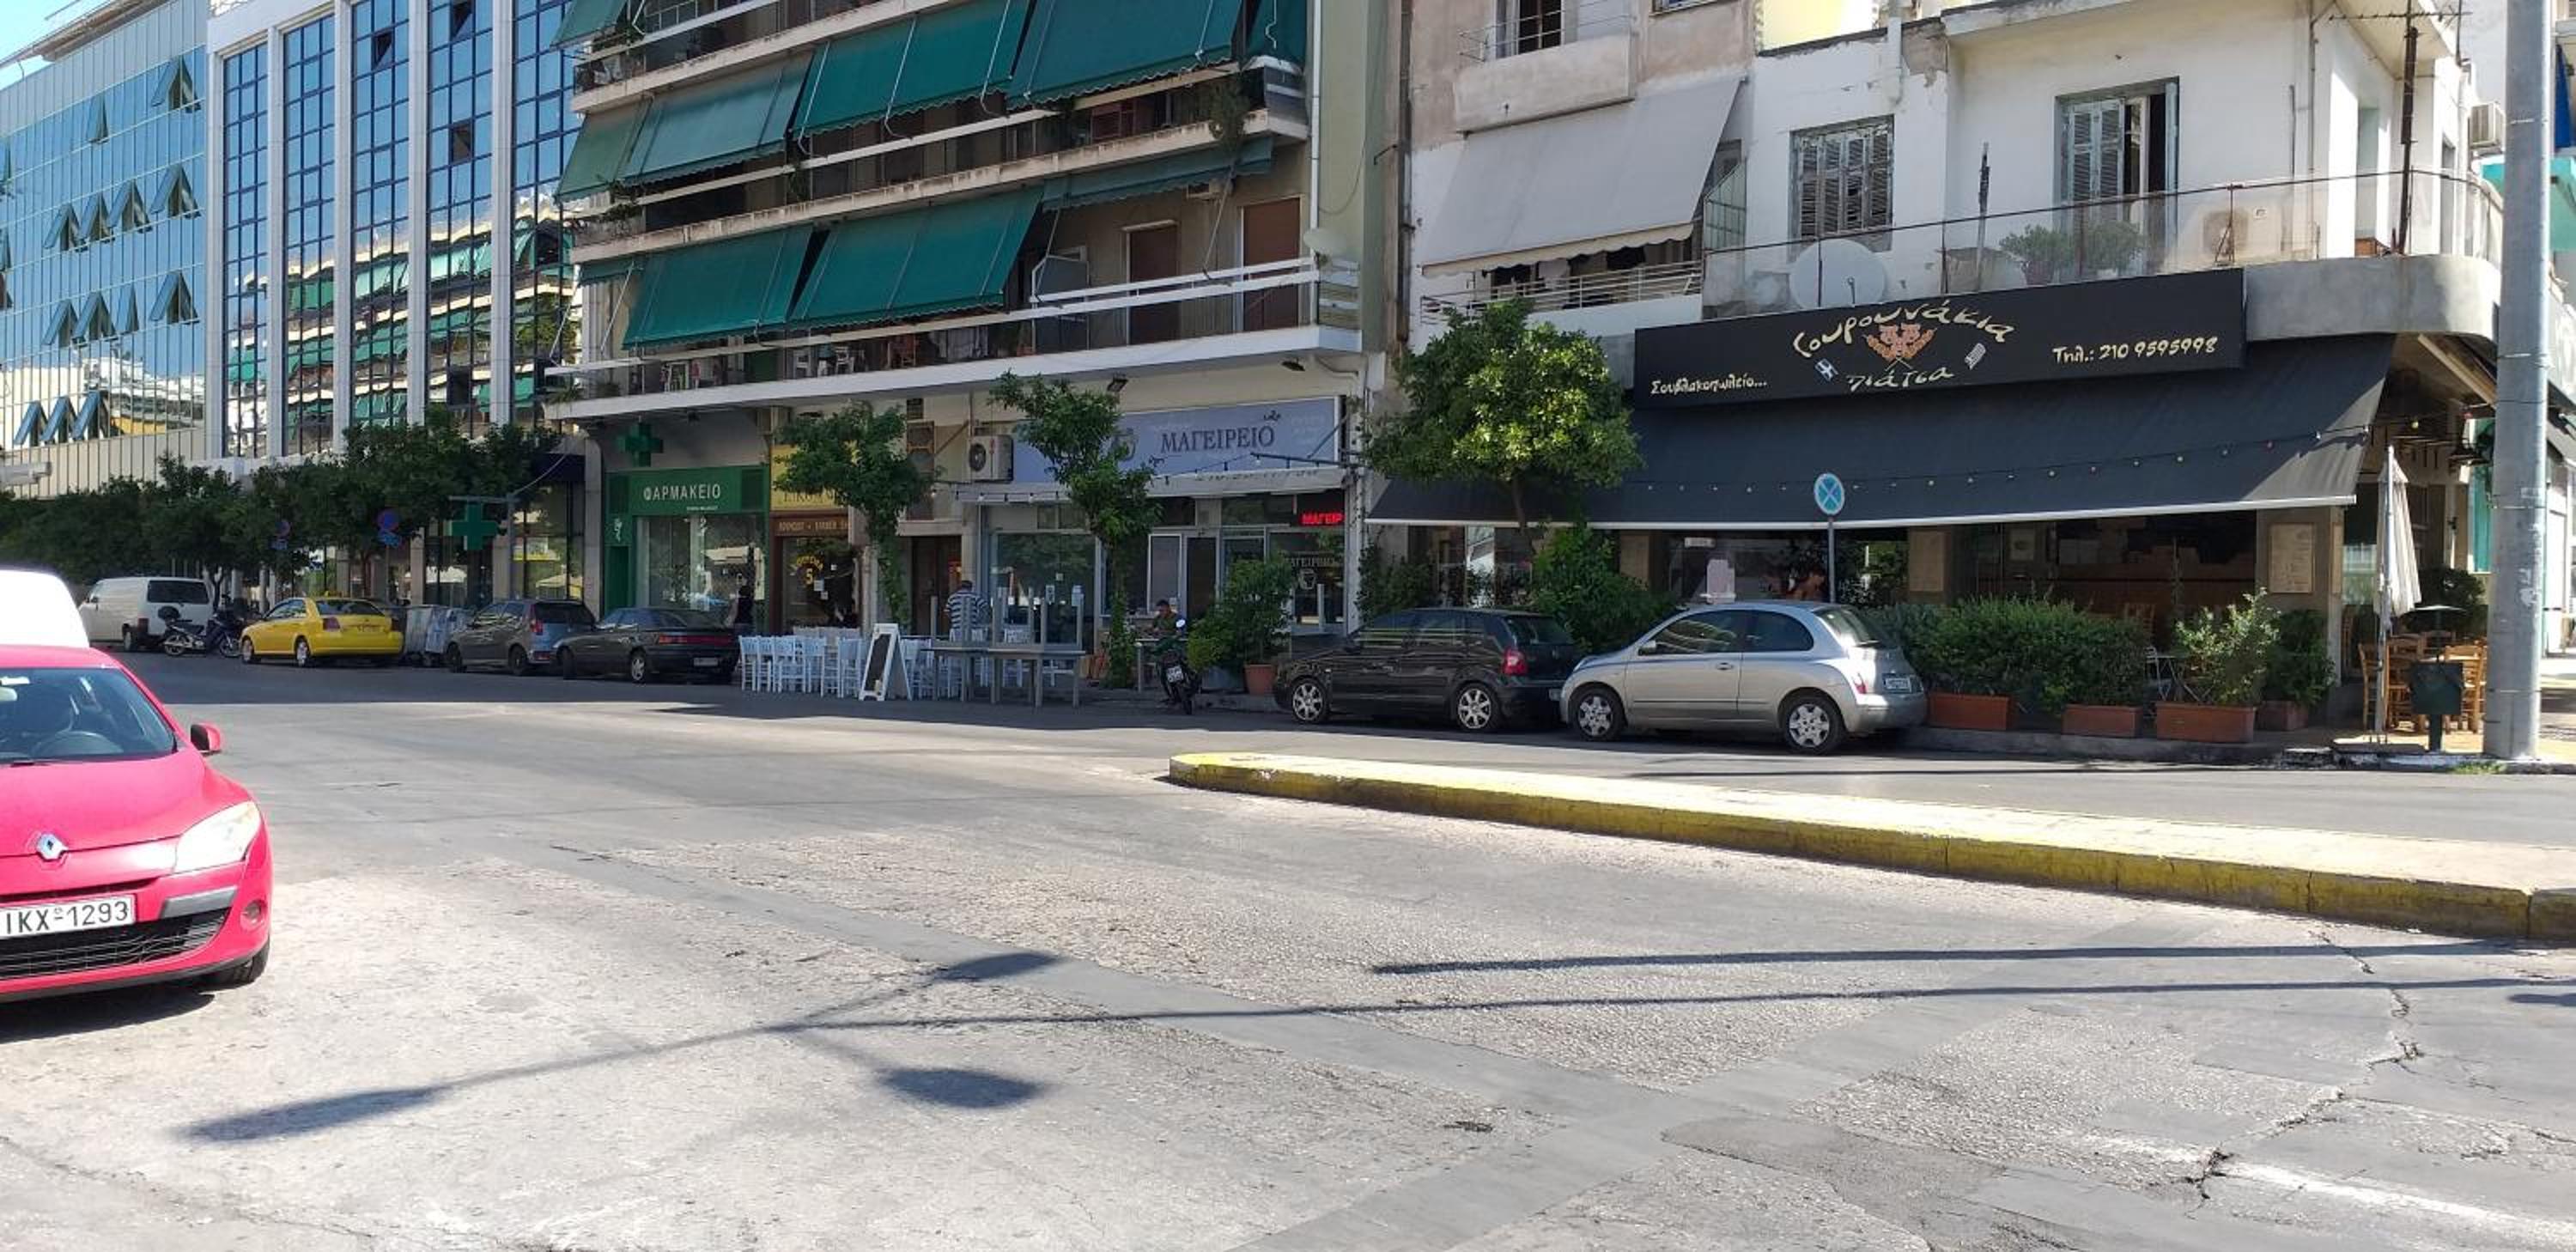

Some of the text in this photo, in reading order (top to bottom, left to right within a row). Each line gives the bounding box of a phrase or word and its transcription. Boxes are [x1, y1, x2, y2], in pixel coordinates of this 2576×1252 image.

[2099, 344, 2129, 360] 210
[2134, 337, 2218, 358] 9595998
[1160, 426, 1276, 454] ΜΑΓΕΙΡΕΙΟ
[643, 483, 721, 501] ΦΑΡΜΑΚΕΙΟ
